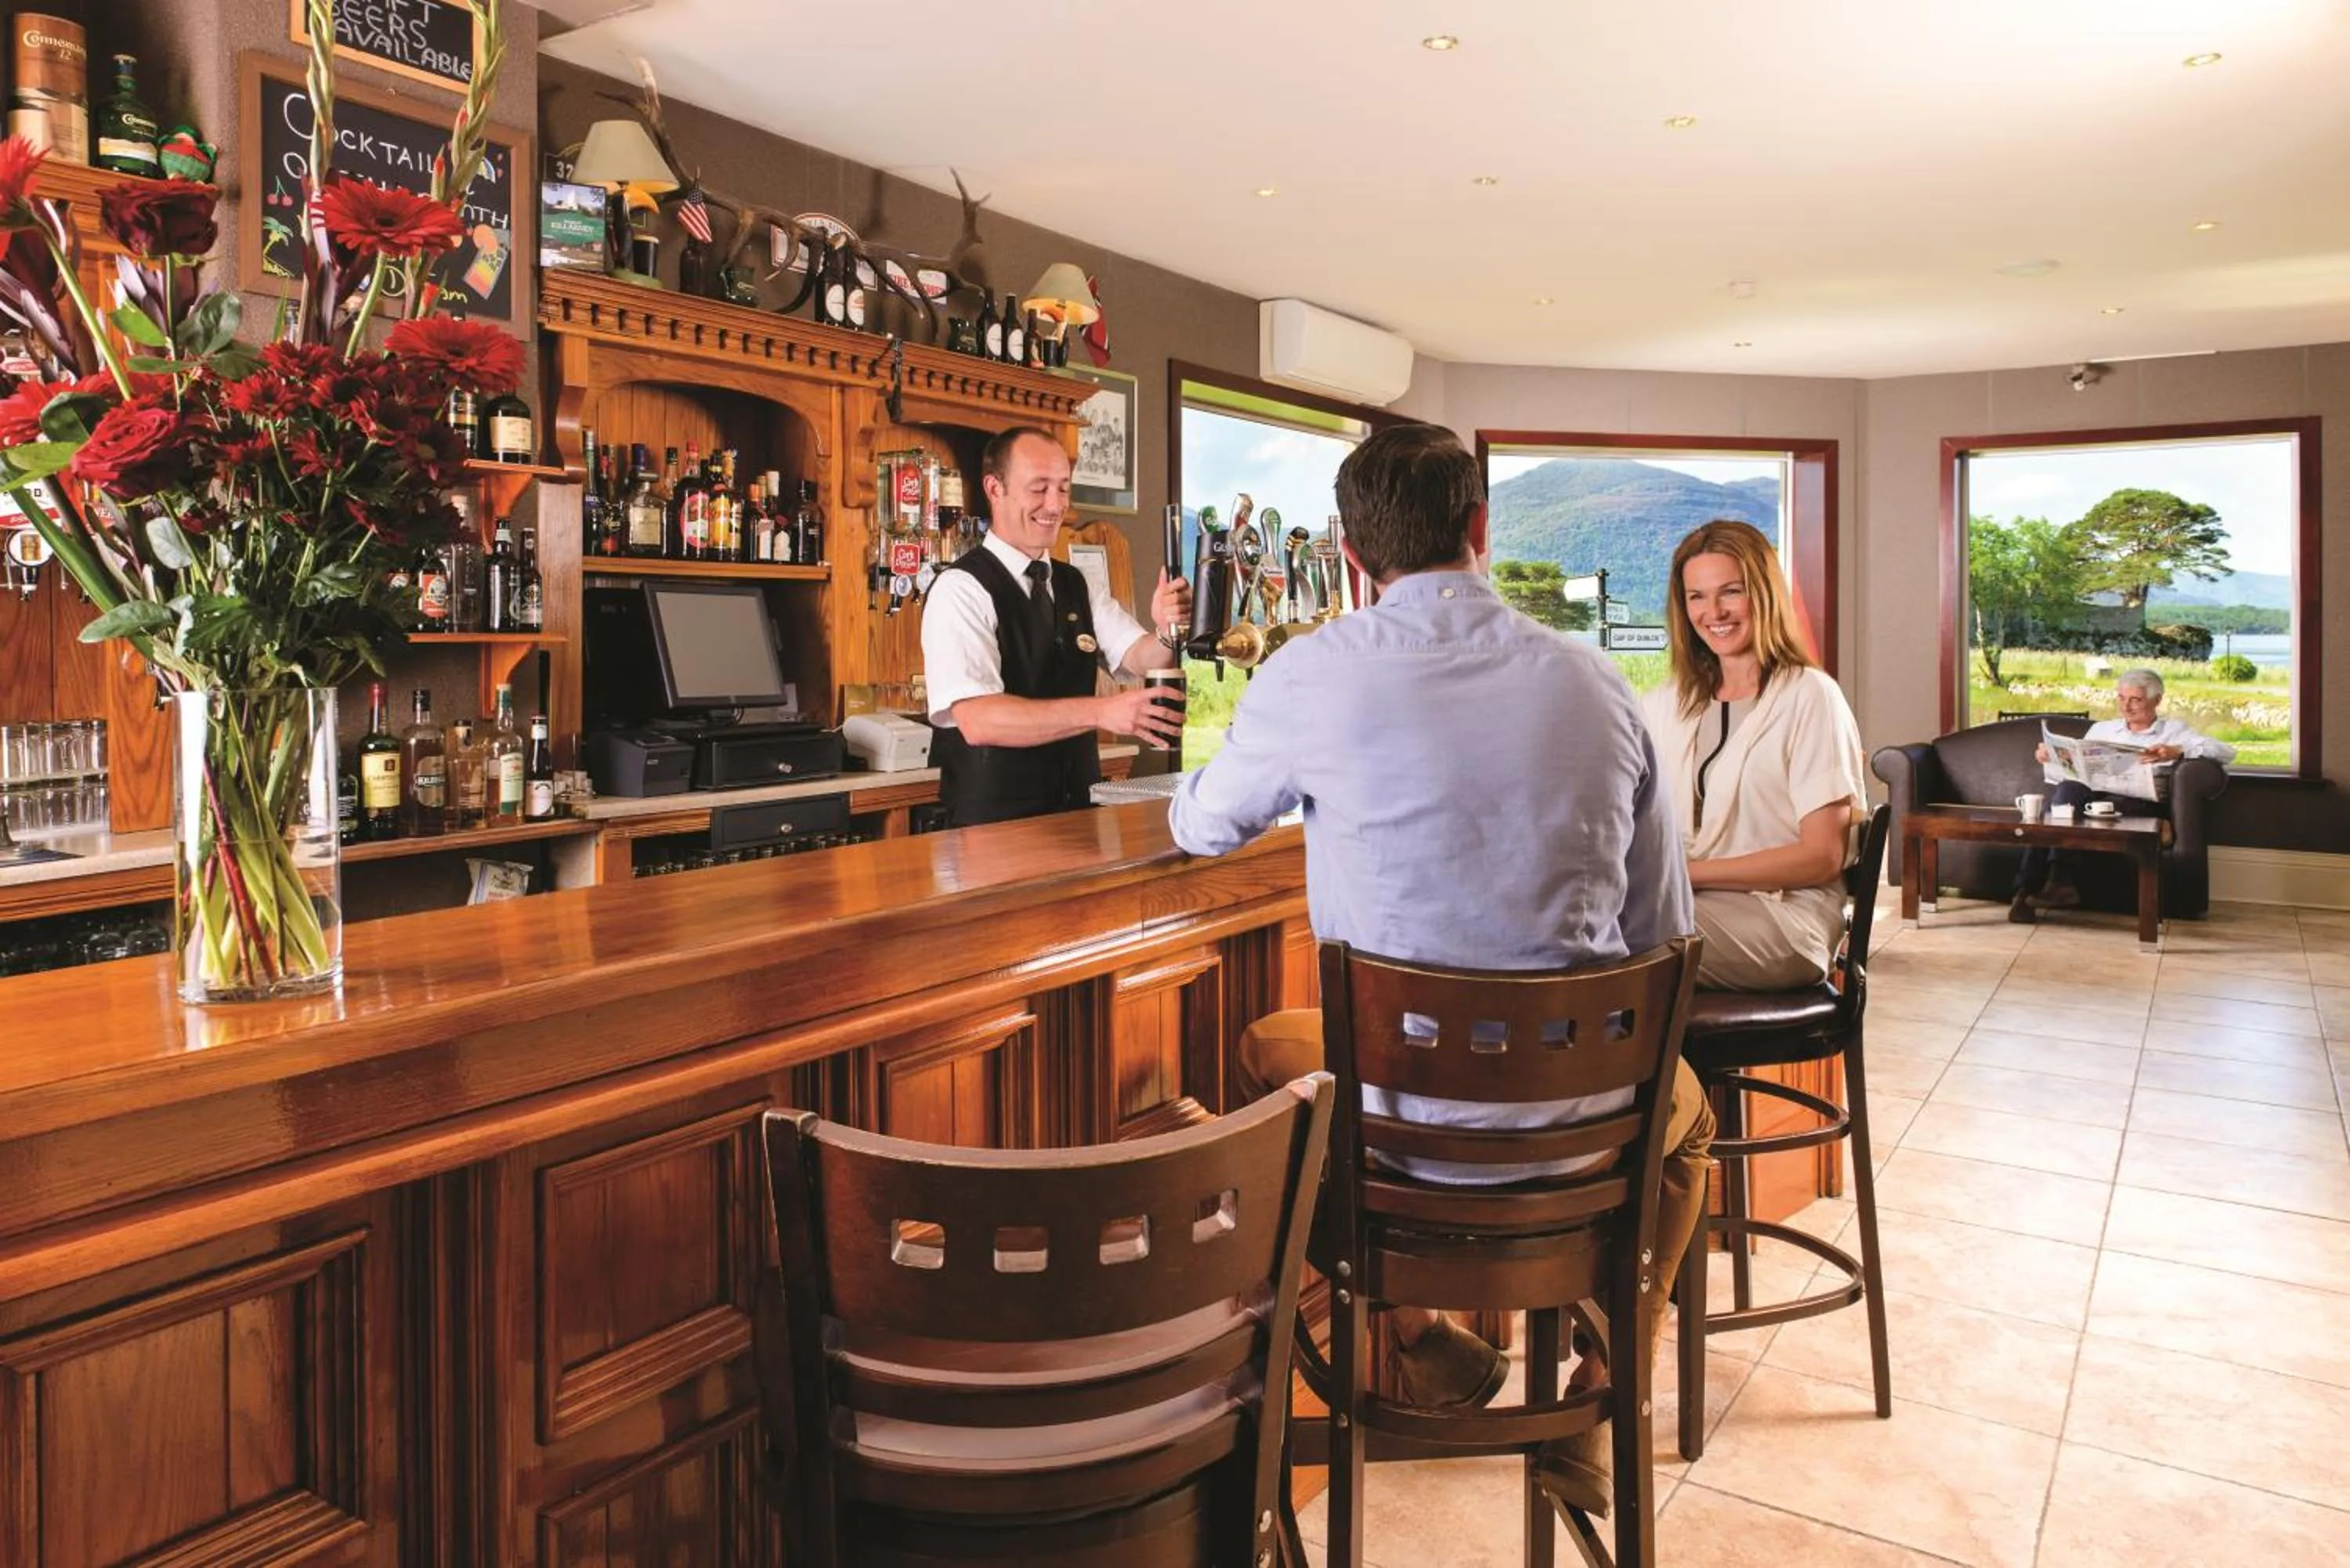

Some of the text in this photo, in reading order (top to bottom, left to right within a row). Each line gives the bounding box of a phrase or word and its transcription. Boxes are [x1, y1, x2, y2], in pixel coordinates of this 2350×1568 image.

[60, 49, 72, 60] 12
[334, 18, 472, 81] AVAILABLE
[284, 92, 436, 174] CCKTAIL
